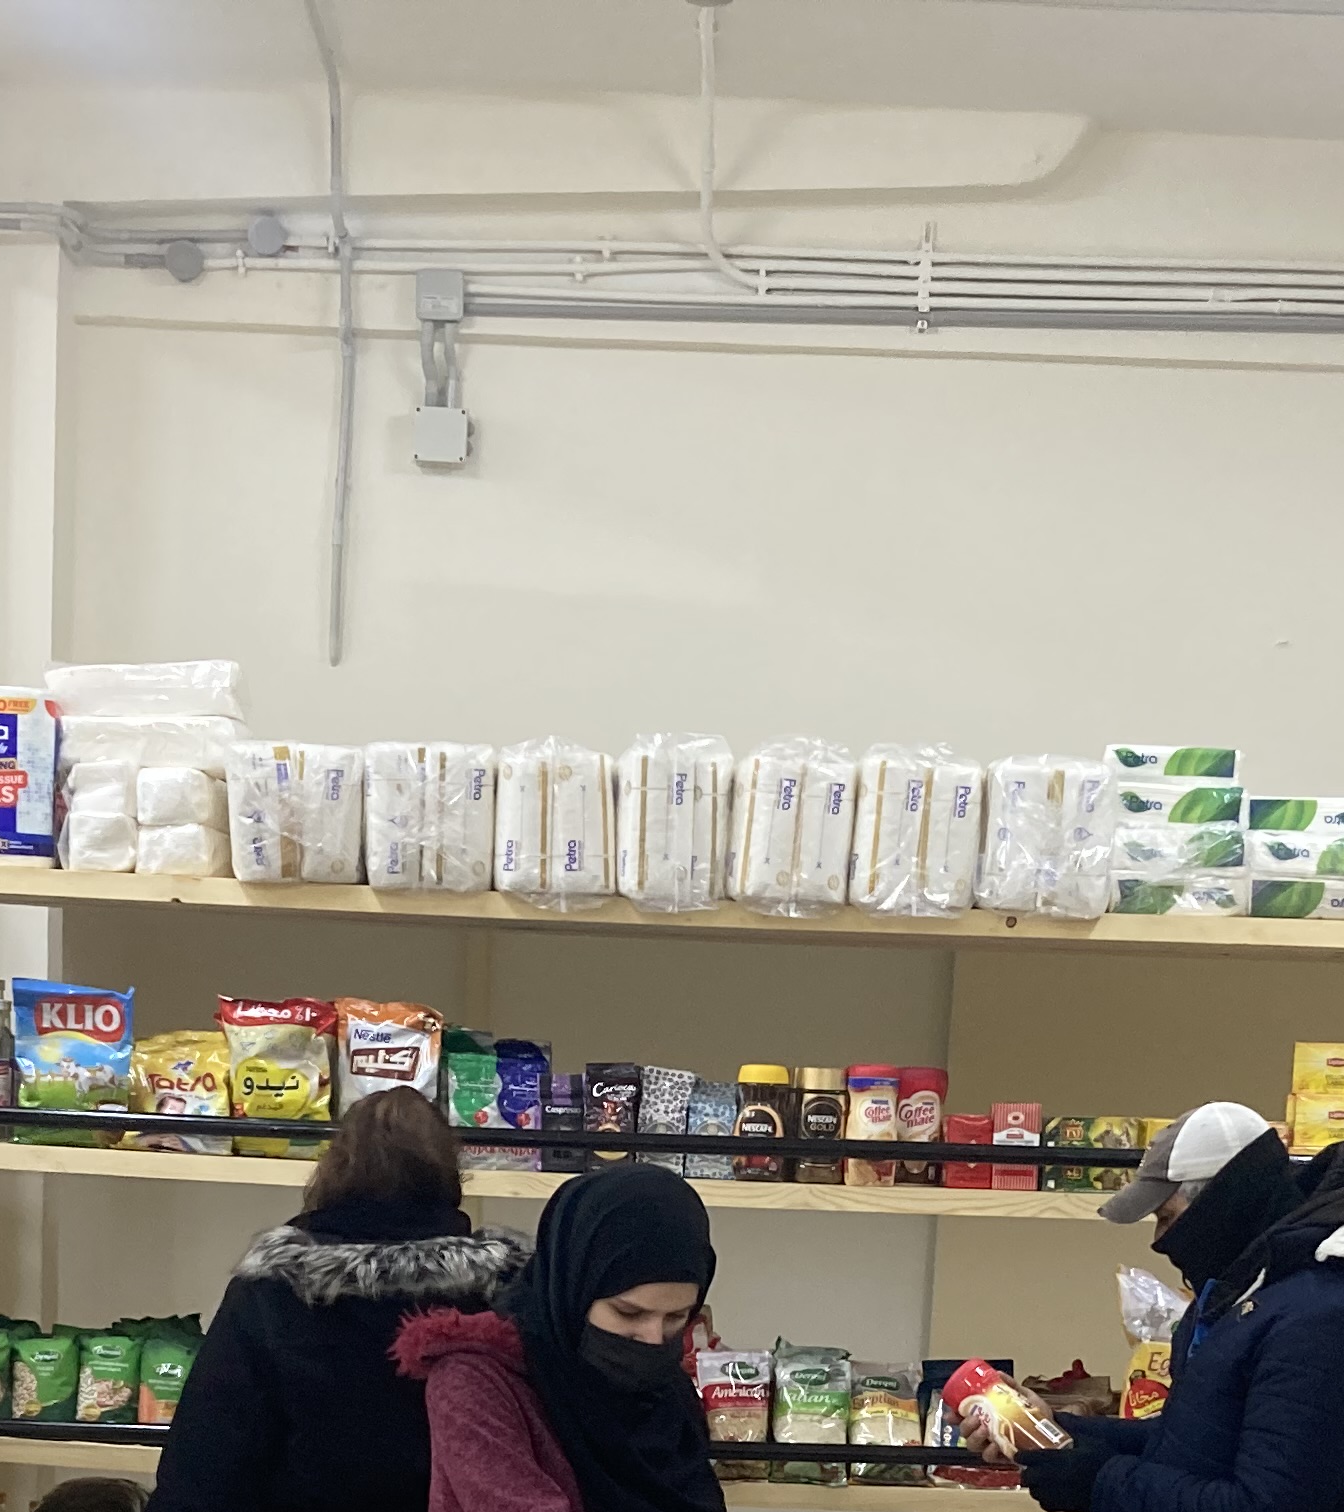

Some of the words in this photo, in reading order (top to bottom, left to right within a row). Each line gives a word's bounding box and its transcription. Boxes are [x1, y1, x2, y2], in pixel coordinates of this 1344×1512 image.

[1126, 751, 1158, 765] Petra
[473, 768, 486, 800] Petra
[675, 773, 687, 806] Petra
[781, 778, 797, 811] Petra
[831, 783, 845, 815] Petra
[957, 786, 971, 818] Petra
[503, 839, 514, 872] Petra
[565, 839, 577, 872] Petra
[41, 1003, 121, 1033] KLIO
[242, 1075, 299, 1097] نيدو
[593, 1082, 637, 1098] Carioca
[864, 1106, 891, 1118] Coffee
[871, 1114, 893, 1124] mate
[899, 1104, 935, 1122] Coffee
[906, 1115, 935, 1128] mate
[809, 1123, 836, 1132] GOLD
[1147, 1352, 1170, 1377] Eg
[712, 1386, 766, 1400] American
